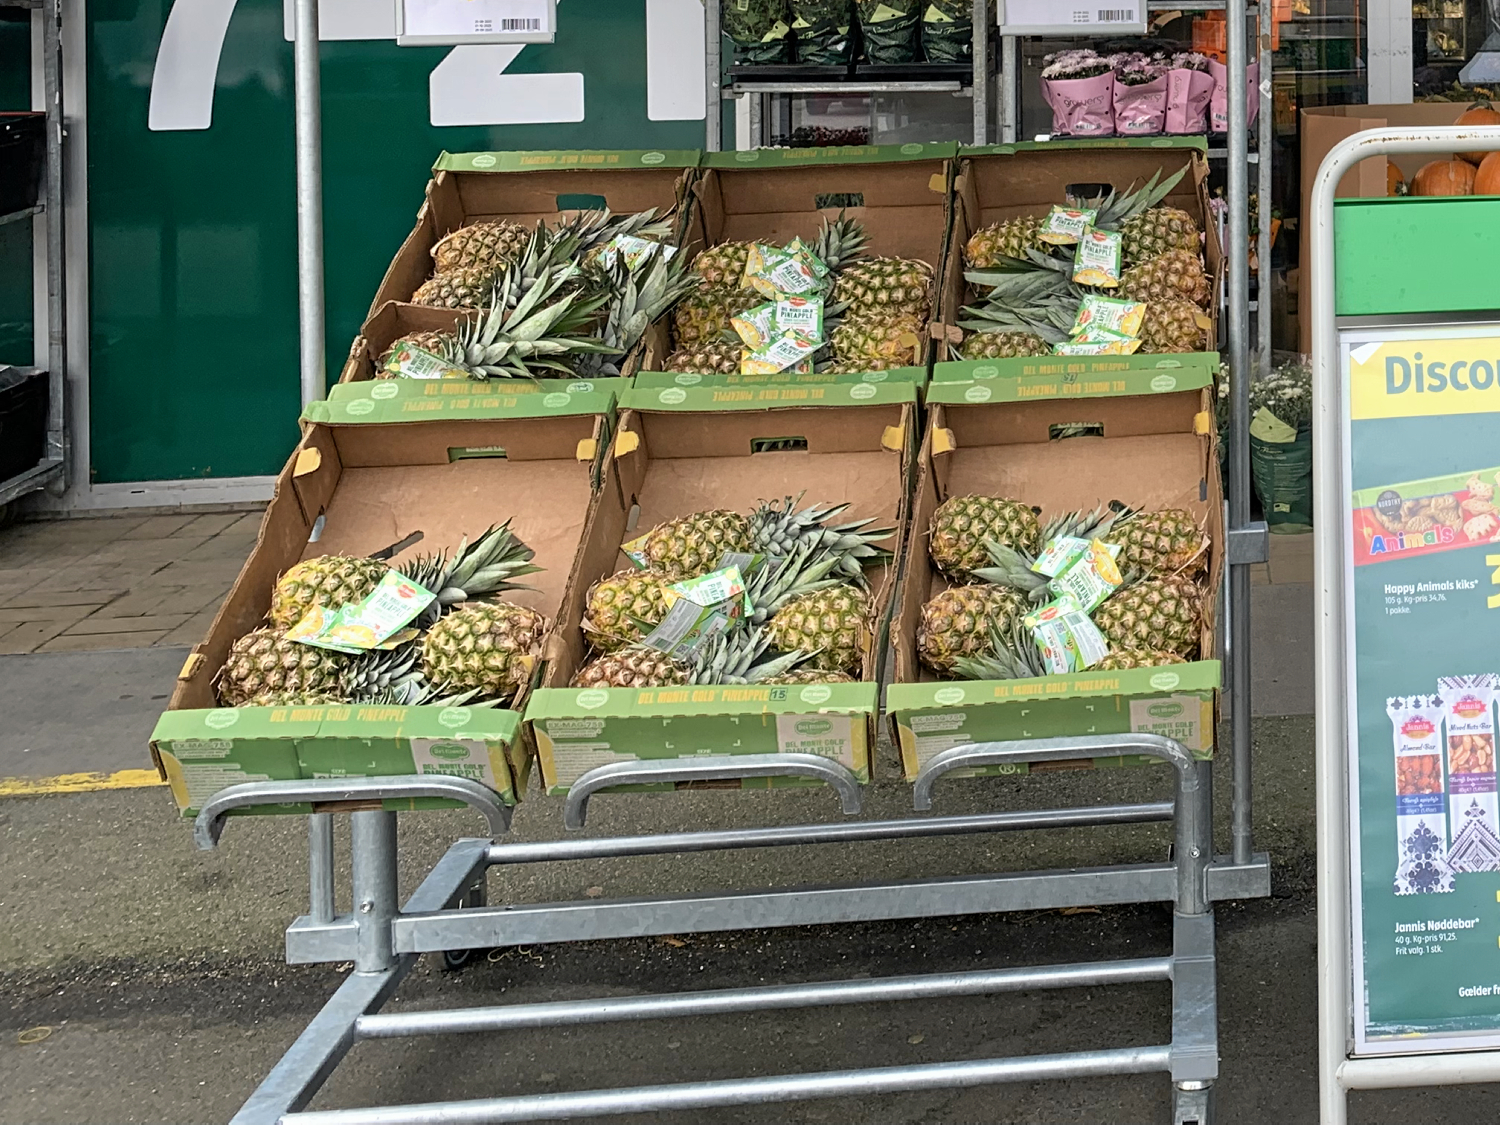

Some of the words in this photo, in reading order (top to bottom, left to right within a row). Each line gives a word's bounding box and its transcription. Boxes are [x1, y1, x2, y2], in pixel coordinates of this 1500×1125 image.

[1369, 524, 1455, 556] Animals
[1384, 583, 1415, 595] Happy
[1417, 580, 1454, 592] Animals
[1385, 596, 1396, 604] 105
[1396, 597, 1403, 605] g.
[1404, 595, 1428, 605] Kg-pris
[1429, 593, 1447, 603] 34,76.
[1389, 606, 1412, 616] pakke.
[994, 686, 1009, 697] DEL
[1013, 683, 1043, 695] MONTE
[1074, 678, 1120, 691] PINEAPPLE
[638, 692, 654, 704] DEL
[657, 690, 690, 702] MONTE
[721, 688, 769, 702] PINEAPPLE
[771, 690, 786, 700] 15
[270, 710, 286, 722] DEL
[290, 709, 323, 722] MONTE
[357, 708, 408, 722] PINEAPPLE
[1394, 921, 1426, 934] Jannis
[1395, 936, 1404, 944] 40
[1405, 937, 1412, 946] g.
[1413, 934, 1438, 945] Kg-pris
[1438, 932, 1458, 941] 91,25.
[1395, 947, 1408, 955] Frit
[1408, 946, 1425, 956] valg.
[1430, 945, 1443, 953] stk.
[1458, 985, 1492, 998] Gælder
